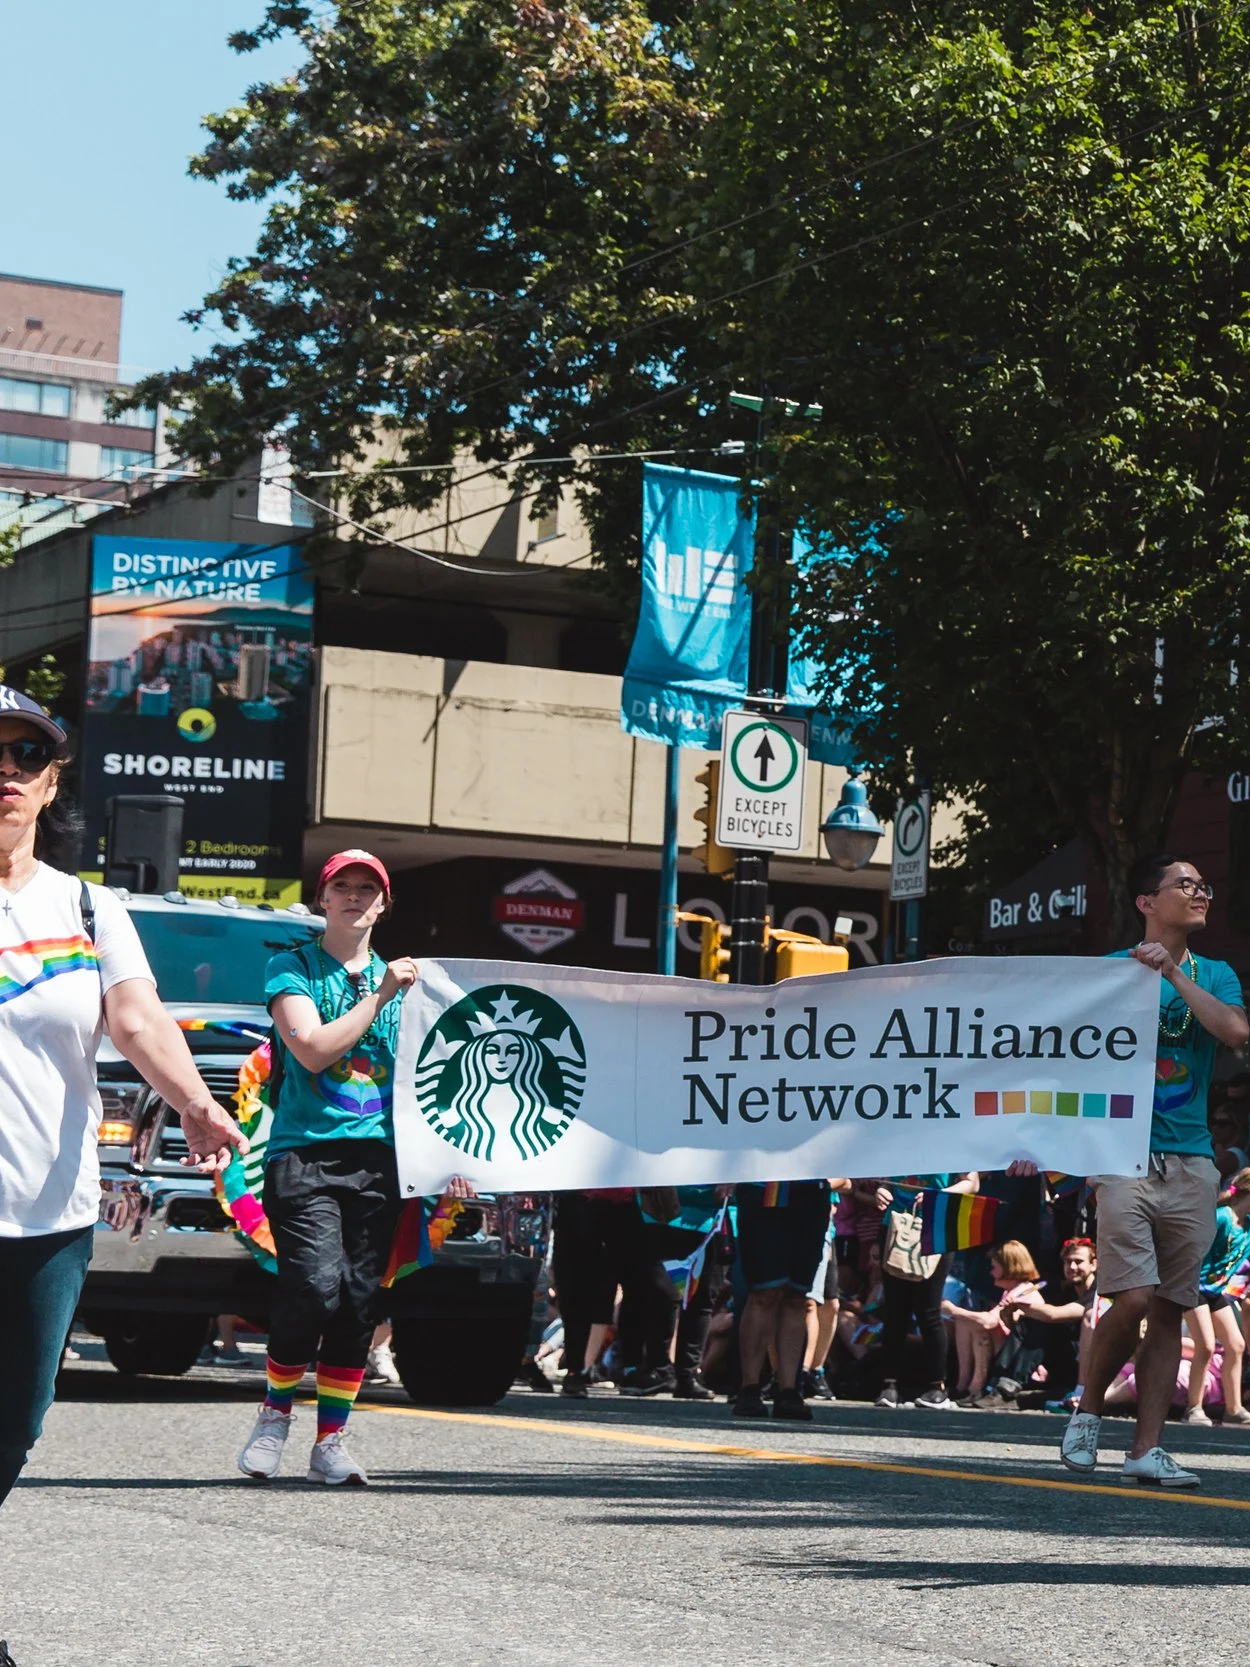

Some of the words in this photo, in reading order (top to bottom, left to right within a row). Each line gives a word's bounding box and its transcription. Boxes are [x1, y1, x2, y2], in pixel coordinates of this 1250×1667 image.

[112, 552, 277, 580] DISTINCTIVE
[112, 576, 147, 597] BY
[153, 578, 262, 602] NATURE
[103, 753, 286, 780] SHORELINE
[735, 798, 789, 817] EXCEPT
[727, 816, 794, 838] BICYCLES
[505, 903, 575, 920] DENMAN
[989, 898, 1022, 929] Bar
[1027, 892, 1043, 923] &
[682, 1006, 856, 1063] Pride
[869, 1006, 1138, 1060] Alliance
[682, 1066, 961, 1126] Network
